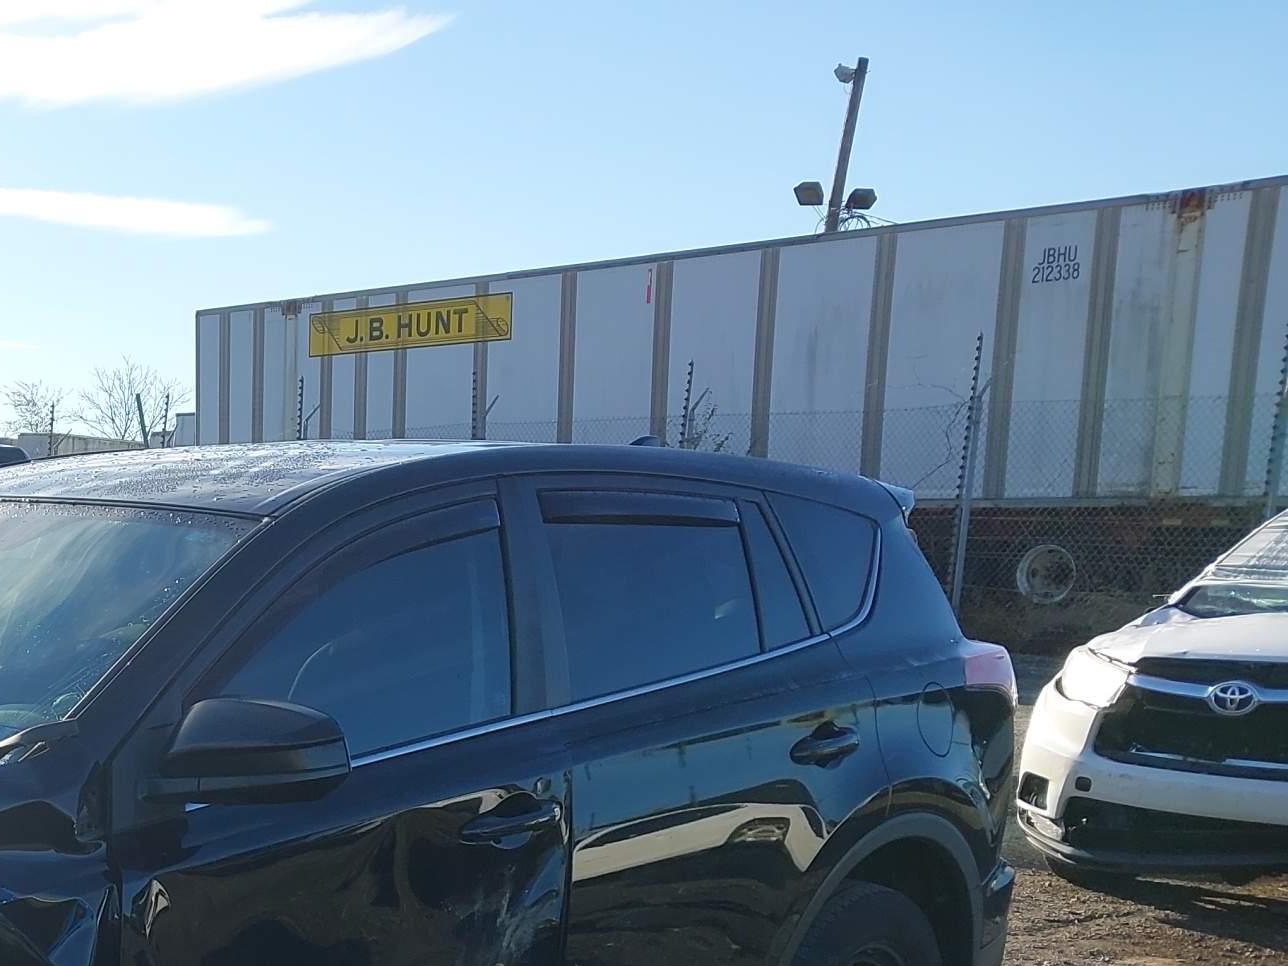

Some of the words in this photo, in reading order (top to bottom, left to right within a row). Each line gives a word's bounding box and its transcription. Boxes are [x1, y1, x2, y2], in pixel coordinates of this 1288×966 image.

[1038, 245, 1078, 265] JBHU
[1032, 262, 1080, 283] 212338
[346, 317, 389, 344] J.B.
[397, 308, 468, 338] HUNT
